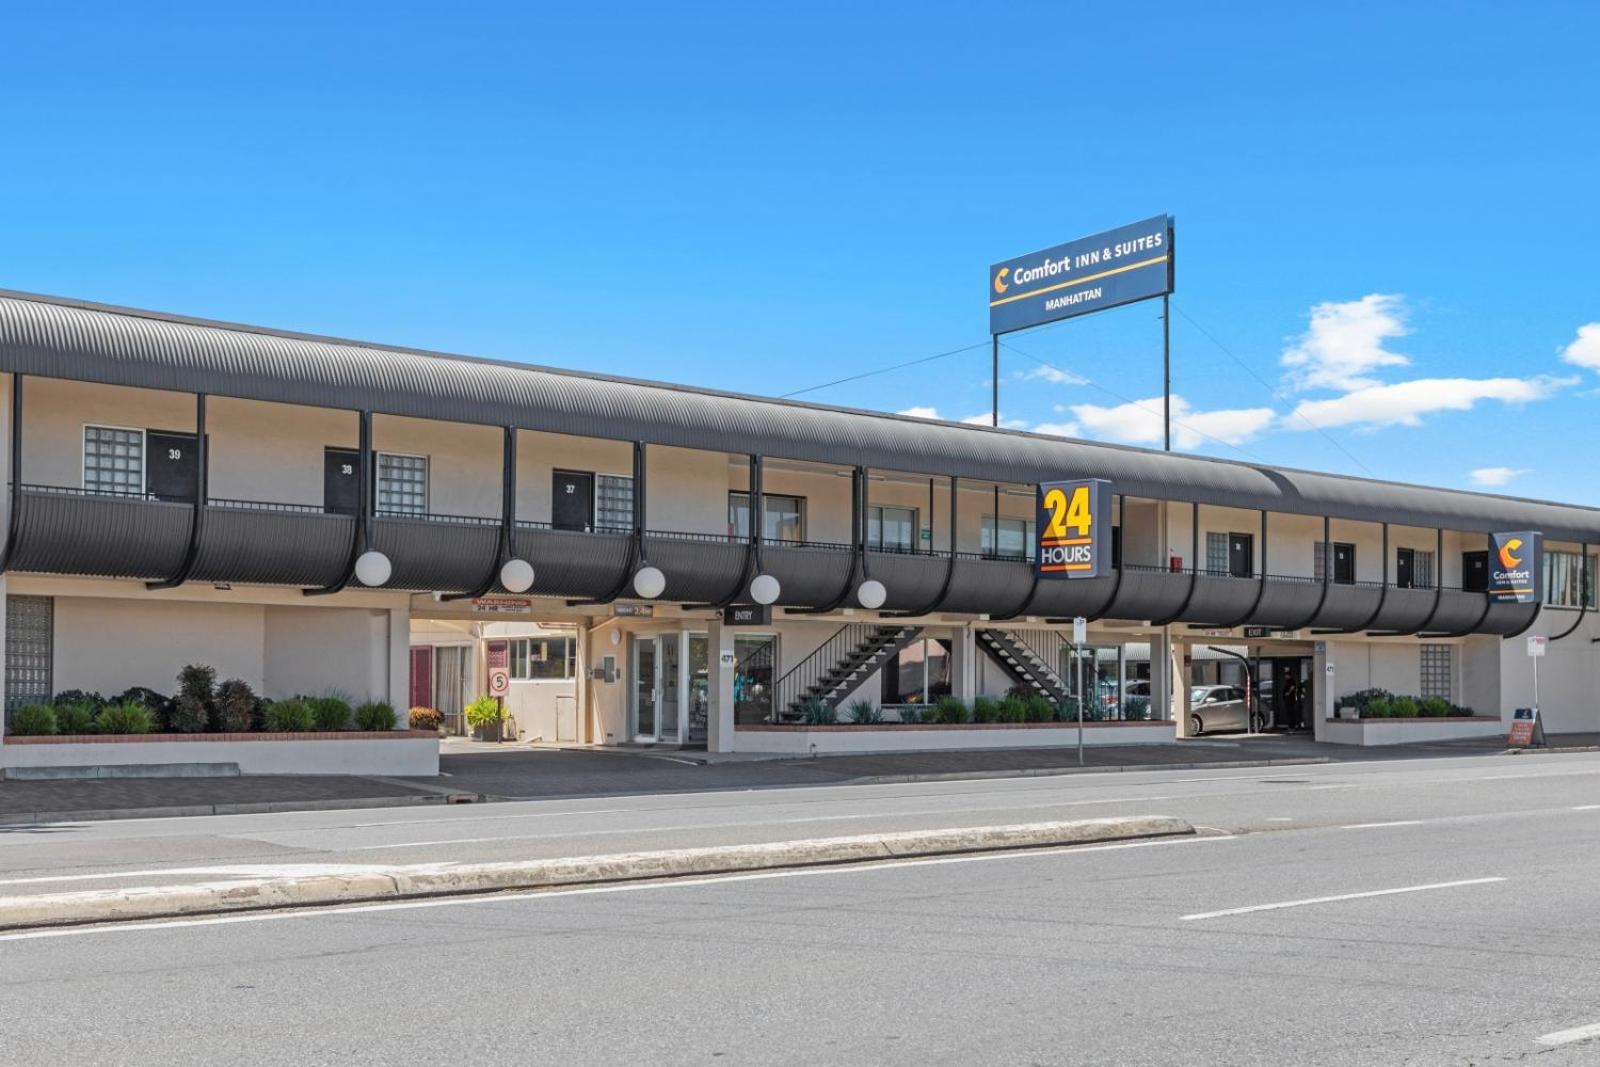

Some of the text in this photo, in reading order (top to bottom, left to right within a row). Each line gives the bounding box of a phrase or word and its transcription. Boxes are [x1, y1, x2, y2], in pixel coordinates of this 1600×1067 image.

[1014, 256, 1071, 285] Comfort
[1076, 250, 1100, 268] INN
[1103, 248, 1112, 260] &
[1115, 233, 1162, 257] SUITES
[1046, 287, 1102, 311] MANHATTAN
[169, 449, 181, 460] 39
[1042, 486, 1092, 539] 24
[1041, 545, 1091, 564] HOURS
[1493, 570, 1530, 580] Comfort
[735, 611, 752, 620] ENTRY
[496, 675, 504, 689] 5
